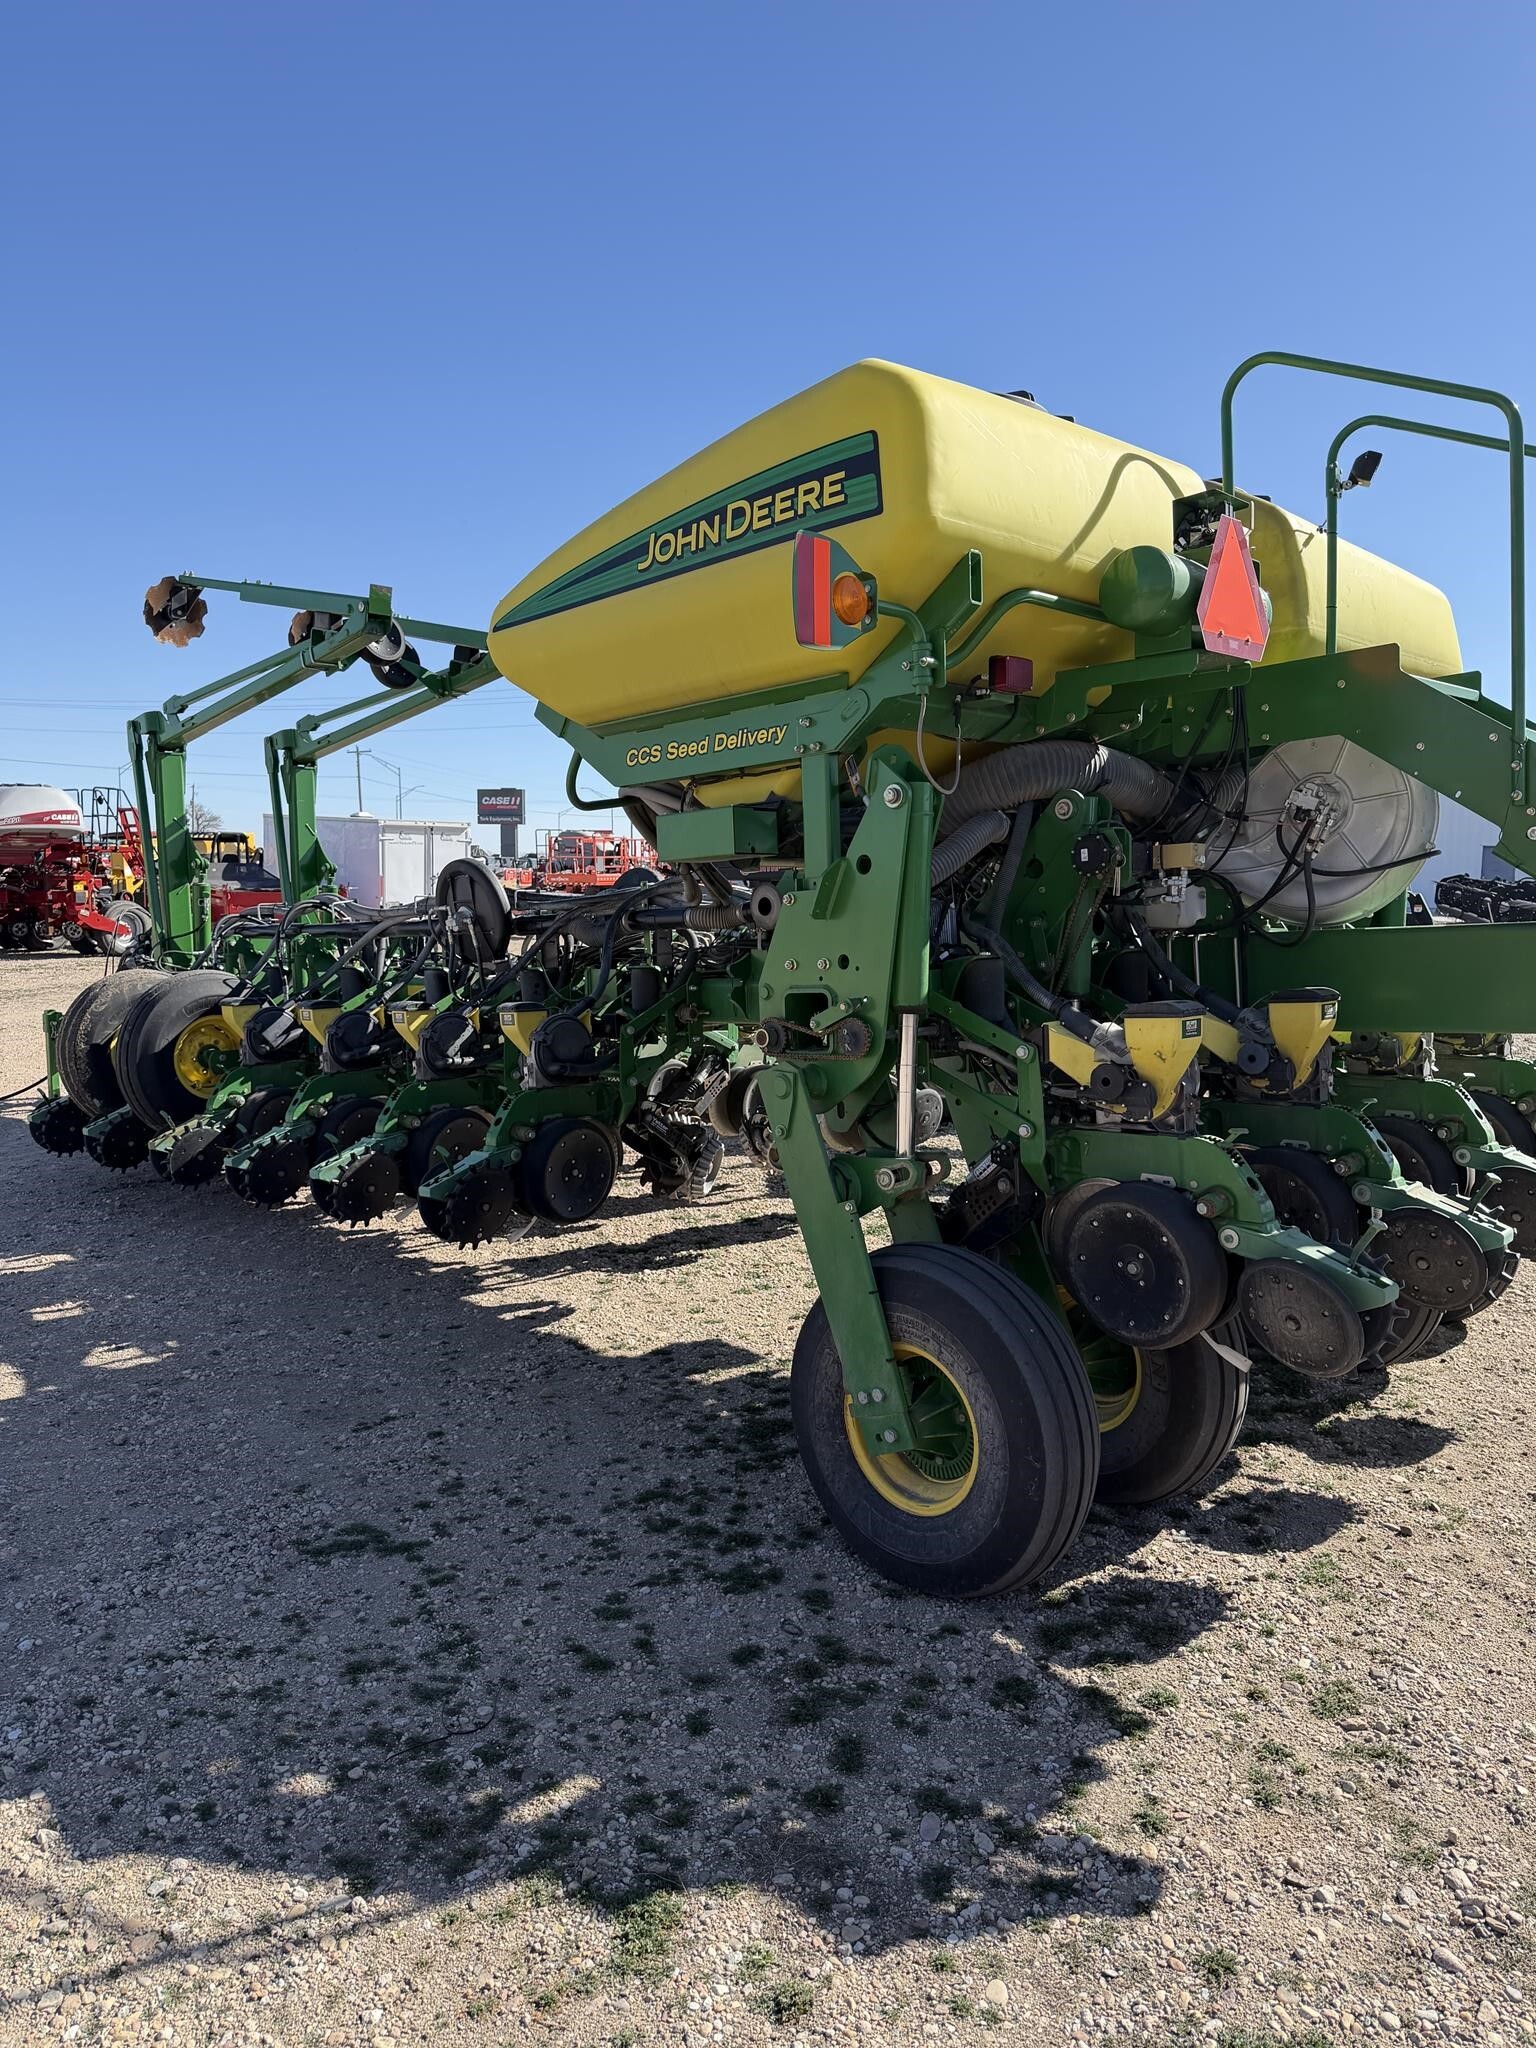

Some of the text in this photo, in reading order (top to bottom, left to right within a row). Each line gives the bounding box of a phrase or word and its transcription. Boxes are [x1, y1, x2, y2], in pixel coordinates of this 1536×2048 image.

[637, 470, 847, 571] JOHN DEERE
[626, 723, 789, 767] CCS Seed Delivery
[482, 796, 510, 805] CASE
